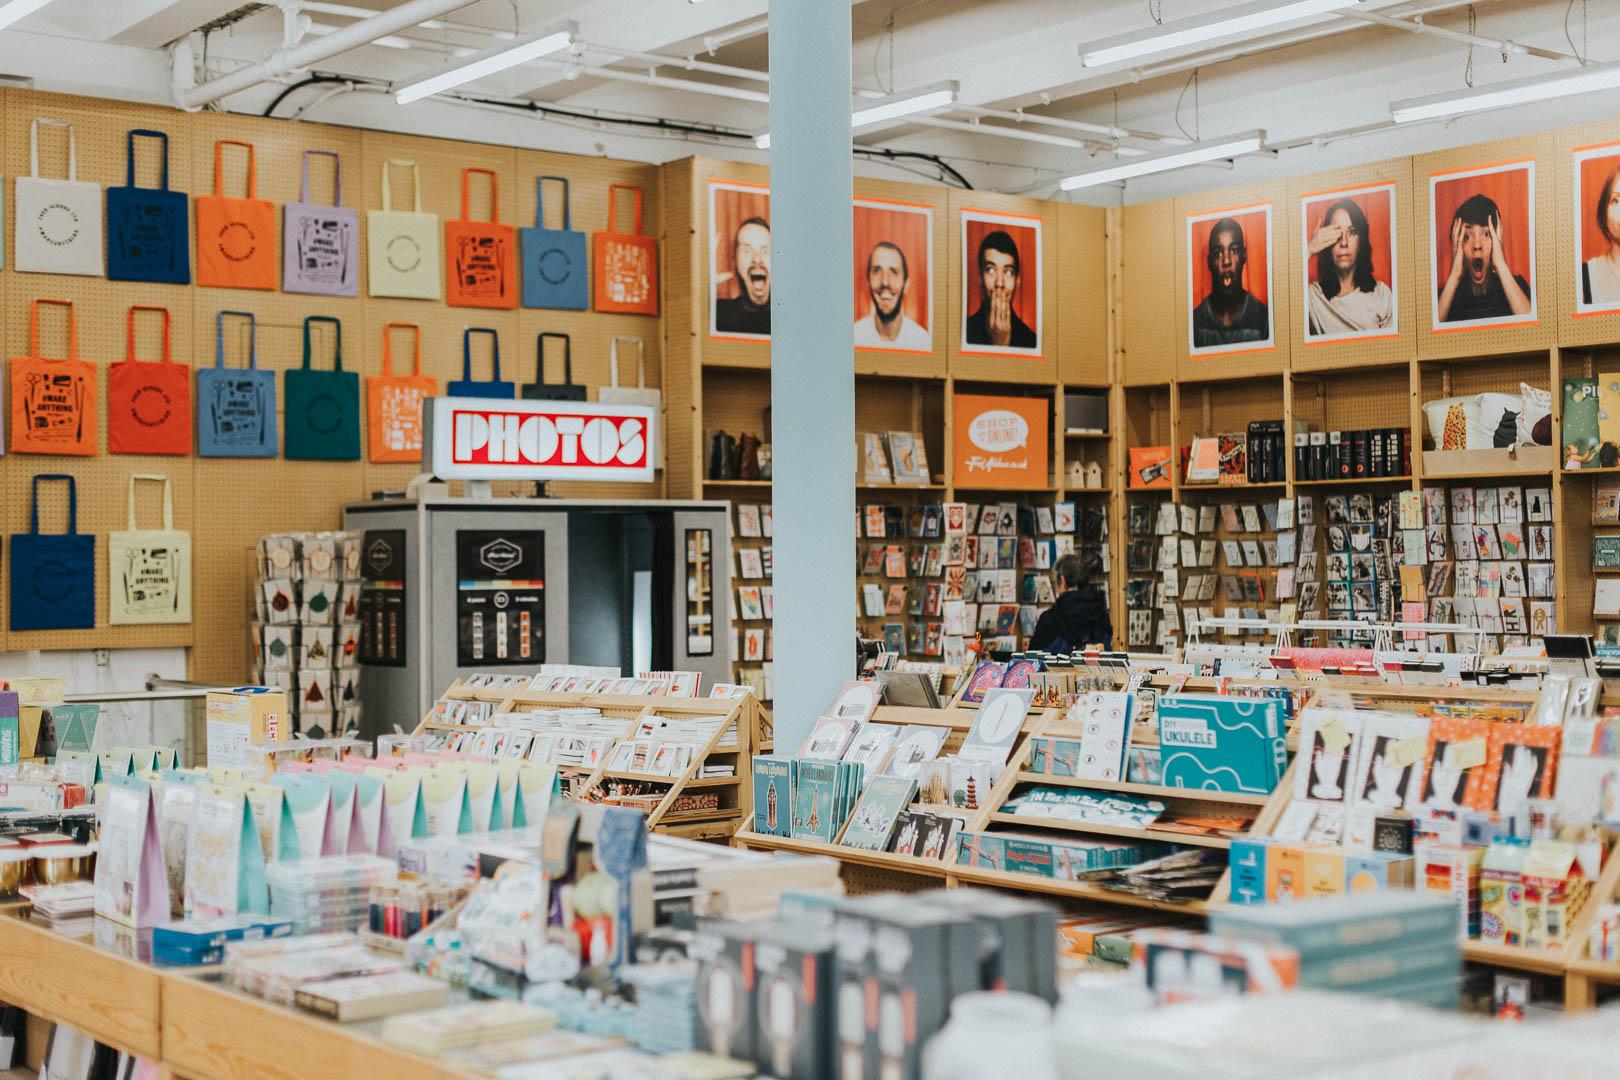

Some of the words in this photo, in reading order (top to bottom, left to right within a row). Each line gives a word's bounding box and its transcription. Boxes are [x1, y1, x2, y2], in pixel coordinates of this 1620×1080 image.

[1582, 384, 1600, 398] PI
[42, 394, 67, 403] #MAKE
[37, 403, 73, 413] ANYTHING
[455, 414, 645, 465] PHOTOS
[135, 577, 169, 585] ANYTHING
[1163, 720, 1176, 728] DIY
[1165, 730, 1213, 745] UKULELE
